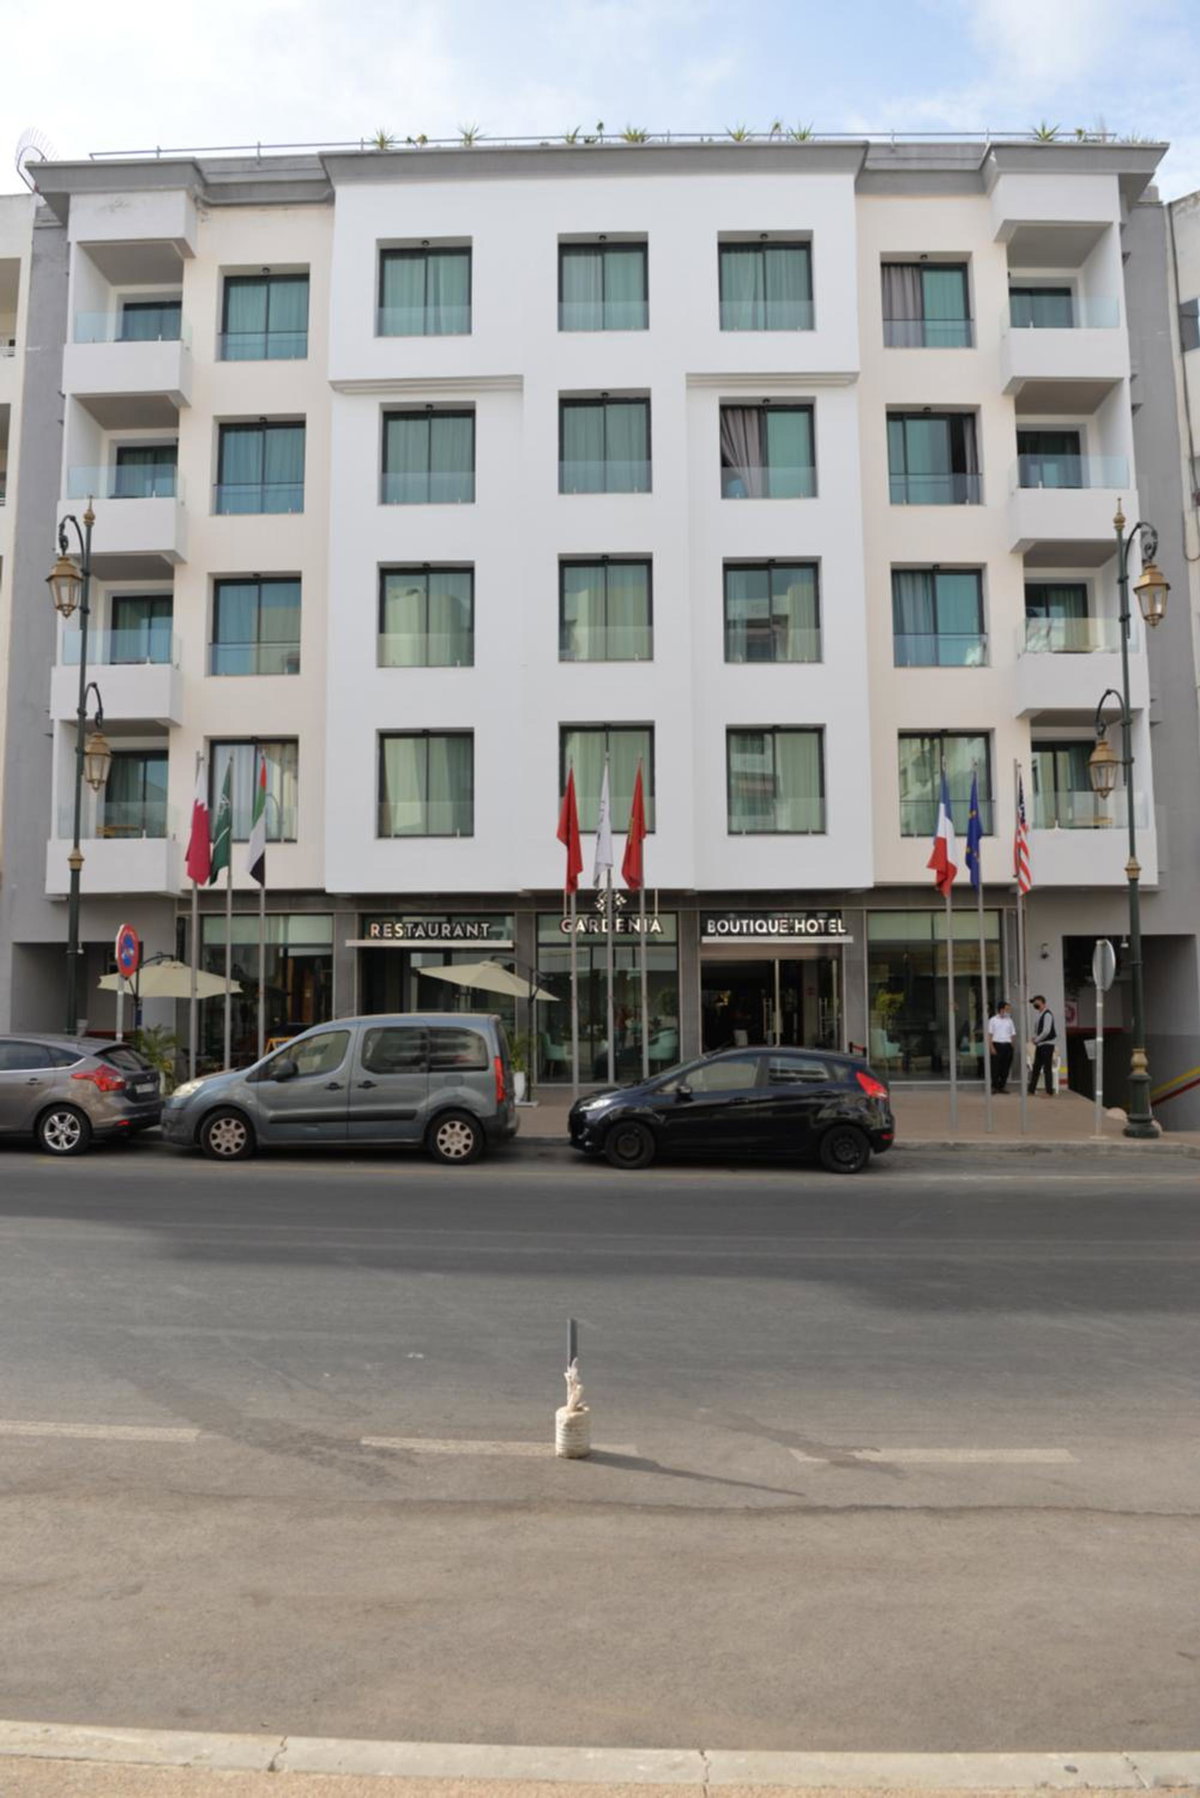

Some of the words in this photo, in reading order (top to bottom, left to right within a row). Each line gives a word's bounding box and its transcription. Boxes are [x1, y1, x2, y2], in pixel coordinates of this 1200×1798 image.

[370, 922, 491, 938] RESTAURANT
[706, 918, 790, 934] BOUTIQUE
[794, 918, 847, 934] HOTEL
